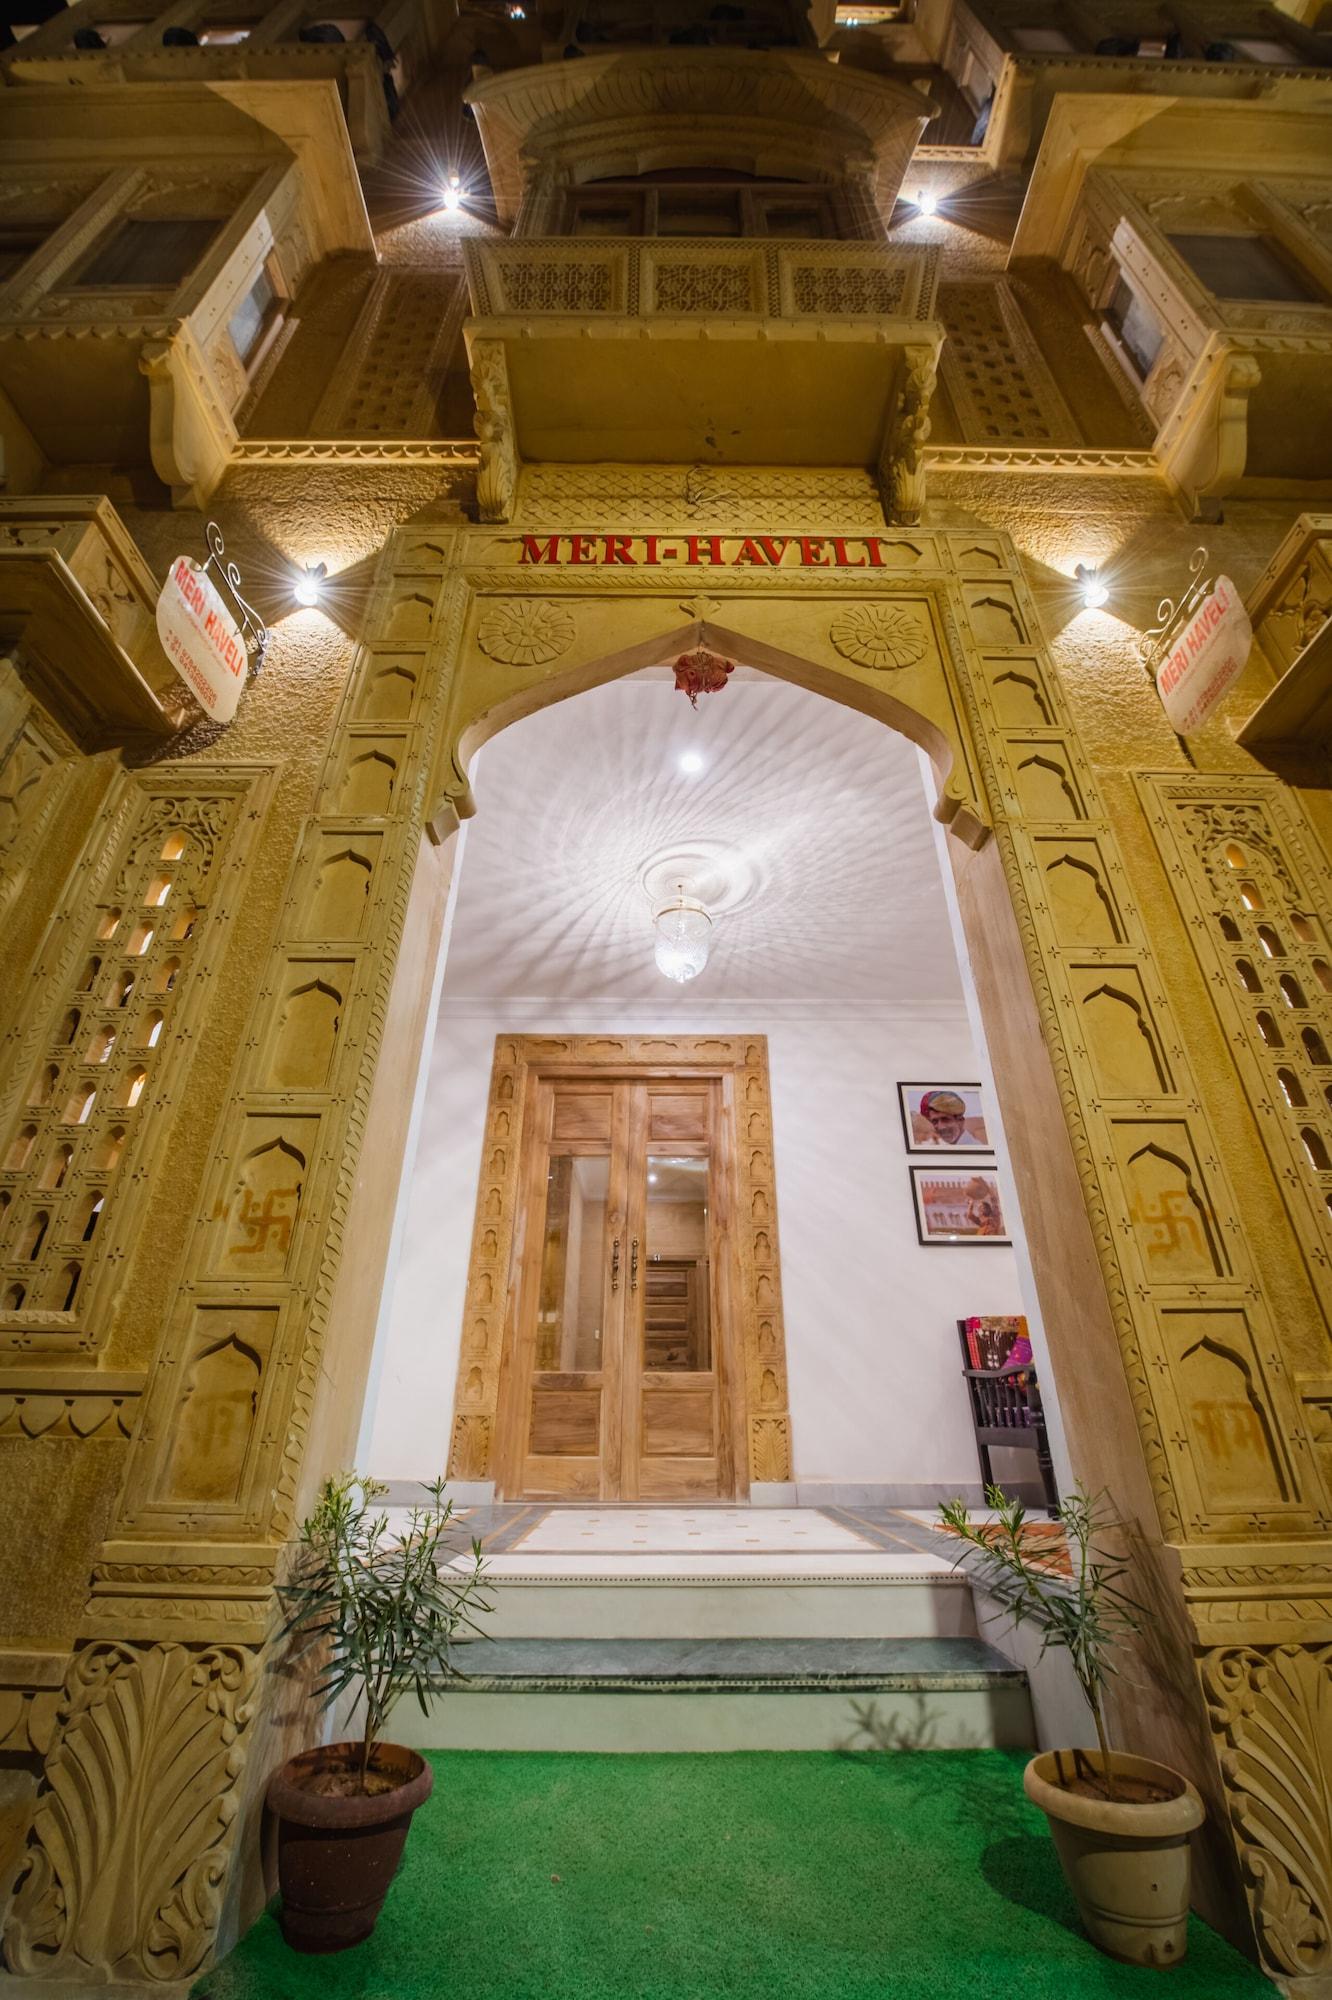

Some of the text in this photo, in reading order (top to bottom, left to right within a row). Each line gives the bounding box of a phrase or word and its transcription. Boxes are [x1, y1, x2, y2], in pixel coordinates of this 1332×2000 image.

[518, 534, 887, 567] MERI-HAVELI
[174, 559, 206, 617] MERI
[204, 611, 244, 677] HAVELI
[1160, 649, 1189, 697] MERI
[1186, 586, 1231, 657] HAVELI
